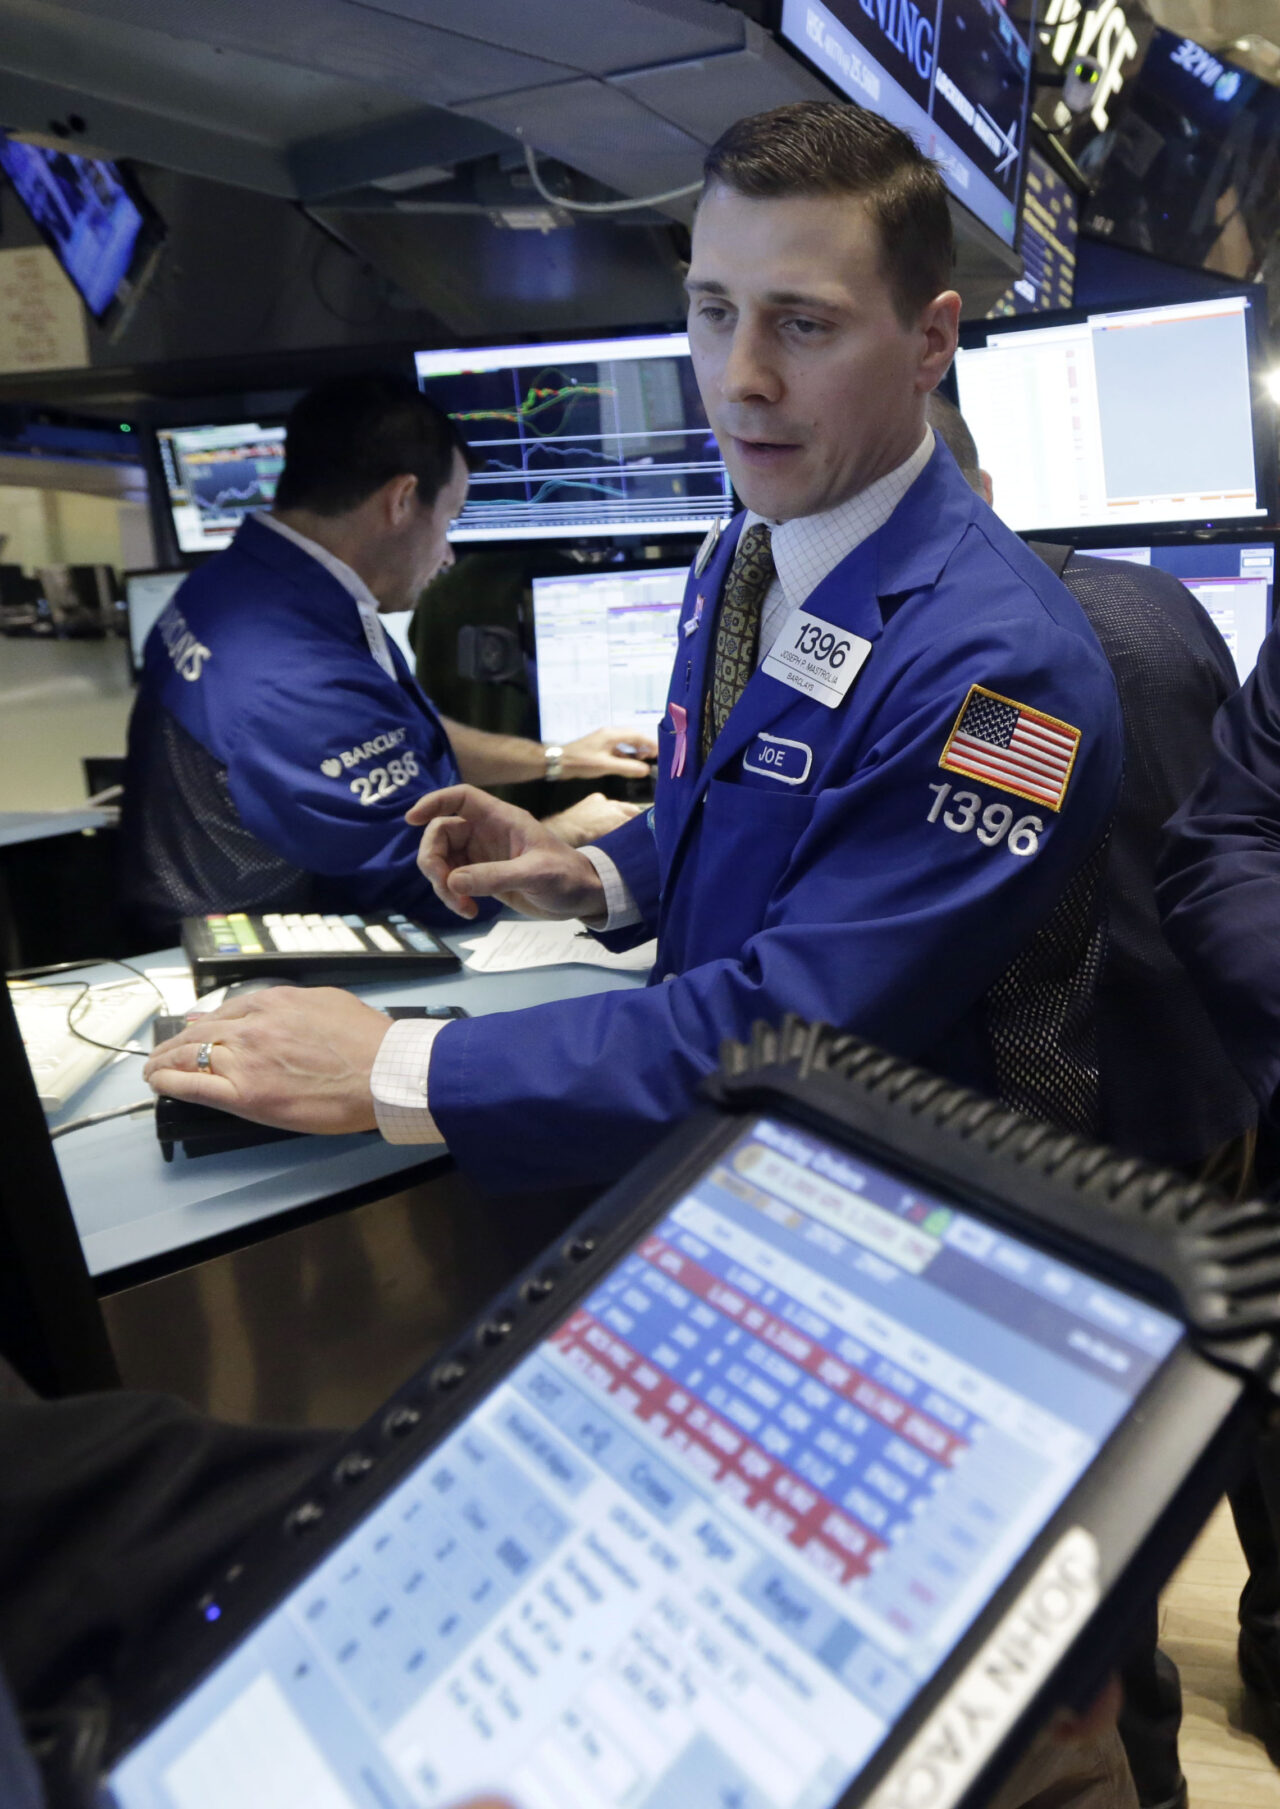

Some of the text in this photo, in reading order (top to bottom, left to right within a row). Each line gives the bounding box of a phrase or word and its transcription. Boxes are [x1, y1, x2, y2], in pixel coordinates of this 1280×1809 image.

[780, 650, 801, 666] JOSEPH
[794, 623, 851, 669] 1396
[758, 747, 786, 767] JOE
[925, 782, 1044, 857] 1396
